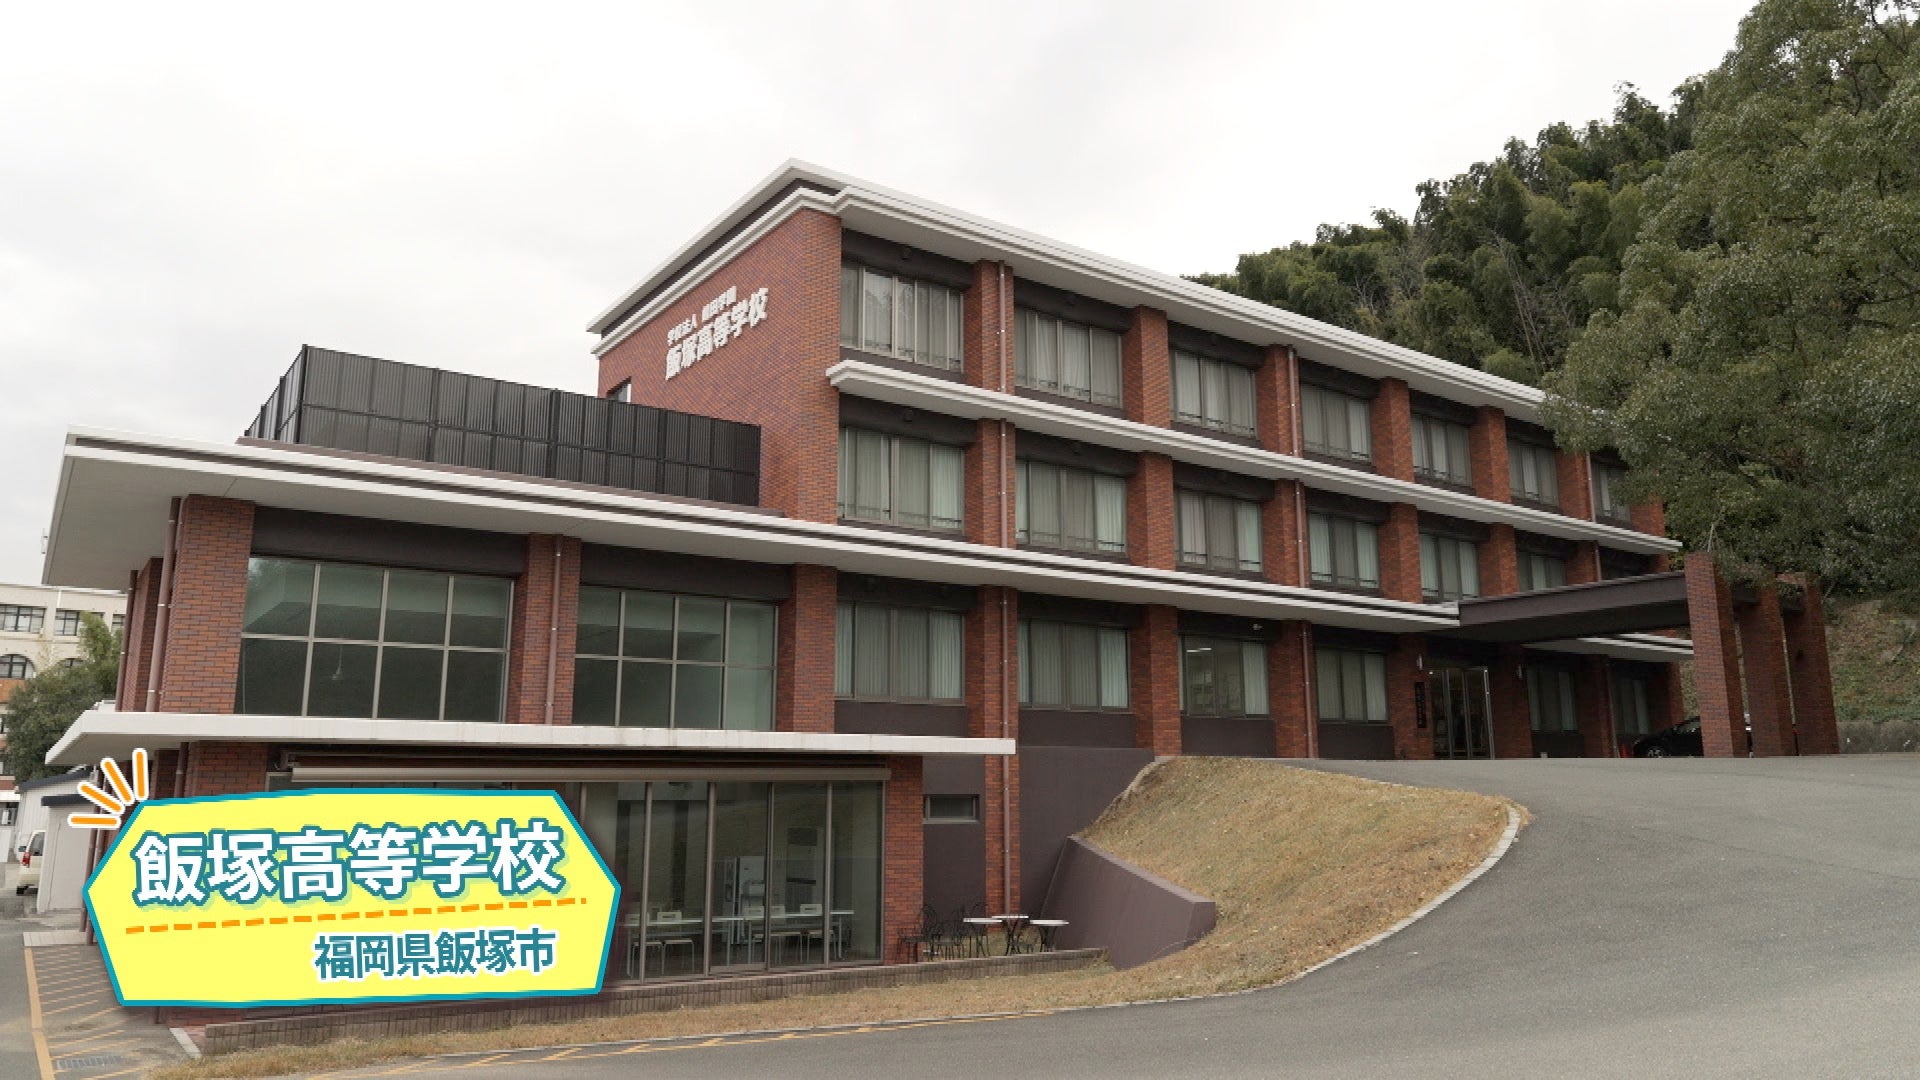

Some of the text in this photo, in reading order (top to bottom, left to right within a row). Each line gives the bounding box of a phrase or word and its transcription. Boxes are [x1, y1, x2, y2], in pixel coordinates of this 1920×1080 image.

[665, 287, 769, 381] 飯塚高等学校
